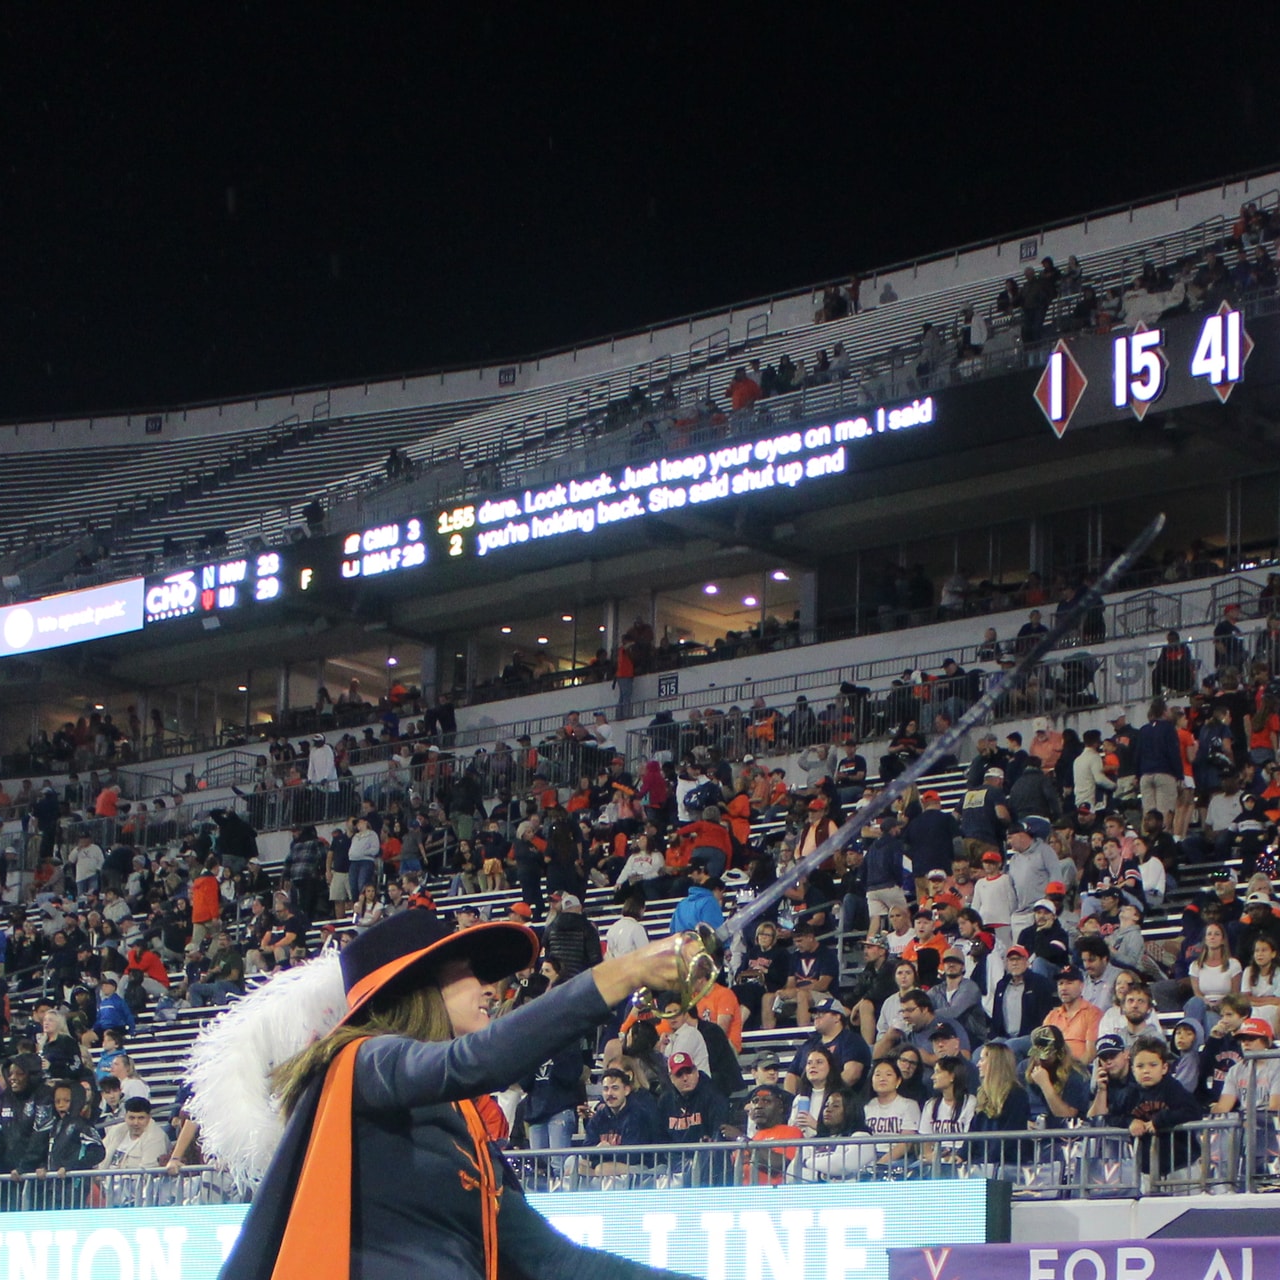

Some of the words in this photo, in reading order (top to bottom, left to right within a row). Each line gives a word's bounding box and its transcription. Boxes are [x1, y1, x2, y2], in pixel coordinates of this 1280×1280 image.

[1114, 329, 1162, 407] 15
[1191, 311, 1240, 385] 41
[478, 500, 521, 525] dare.
[525, 487, 567, 513] Look
[570, 475, 617, 503] back.
[620, 462, 659, 489] Just
[661, 453, 707, 485] keep
[709, 443, 752, 475] your
[755, 434, 802, 464] eyes
[804, 427, 831, 449] on
[835, 417, 873, 442] me.
[877, 407, 885, 434] I
[888, 397, 934, 429] said
[478, 522, 530, 556] you're
[532, 508, 595, 541] holding
[597, 496, 646, 525] back.
[649, 486, 686, 513] She
[689, 475, 729, 504] said
[732, 463, 774, 493] shut
[777, 459, 802, 488] up
[805, 446, 845, 479] and
[407, 519, 421, 541] 3
[449, 533, 463, 556] 2
[301, 568, 313, 590] F
[660, 682, 678, 698] 315
[866, 1116, 903, 1134] IRGINI
